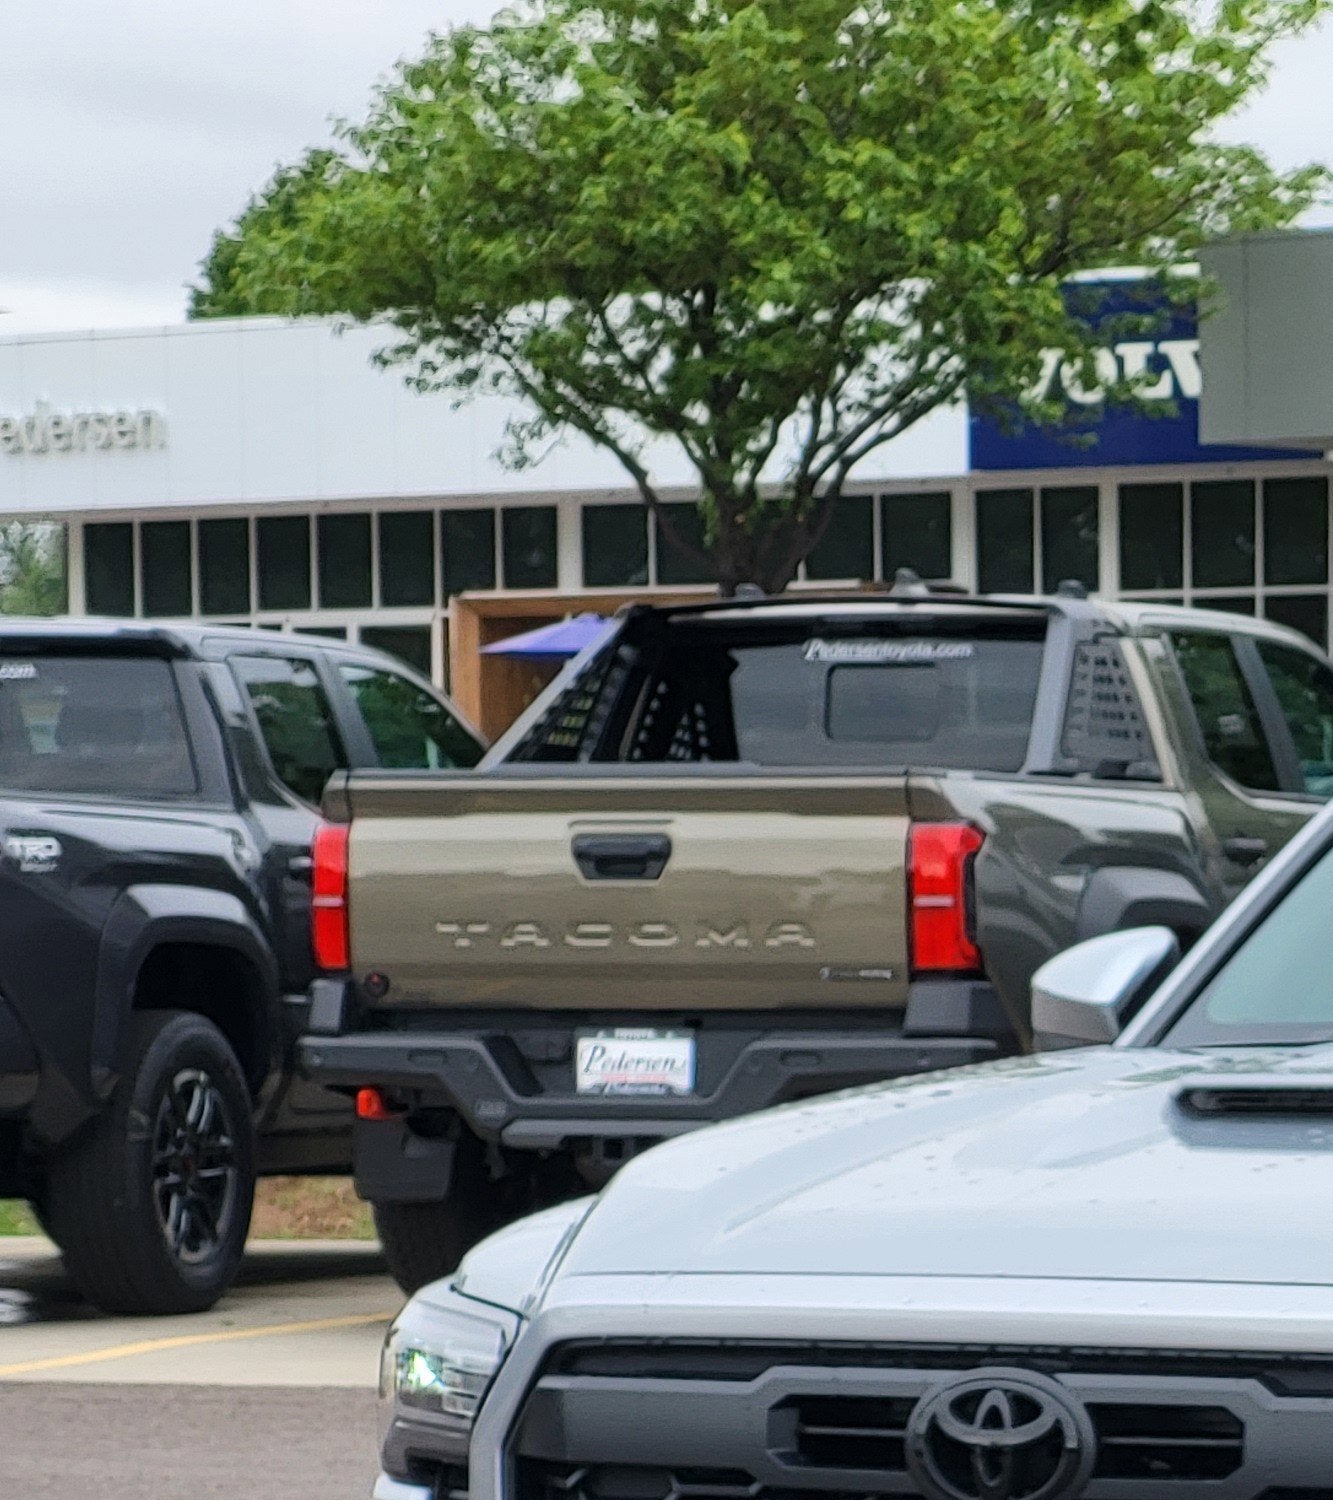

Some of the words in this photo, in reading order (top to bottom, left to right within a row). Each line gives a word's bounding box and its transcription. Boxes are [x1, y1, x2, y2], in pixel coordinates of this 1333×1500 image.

[0, 397, 170, 456] edersen
[436, 921, 816, 949] TACOMA
[580, 1044, 688, 1074] Pedersen
